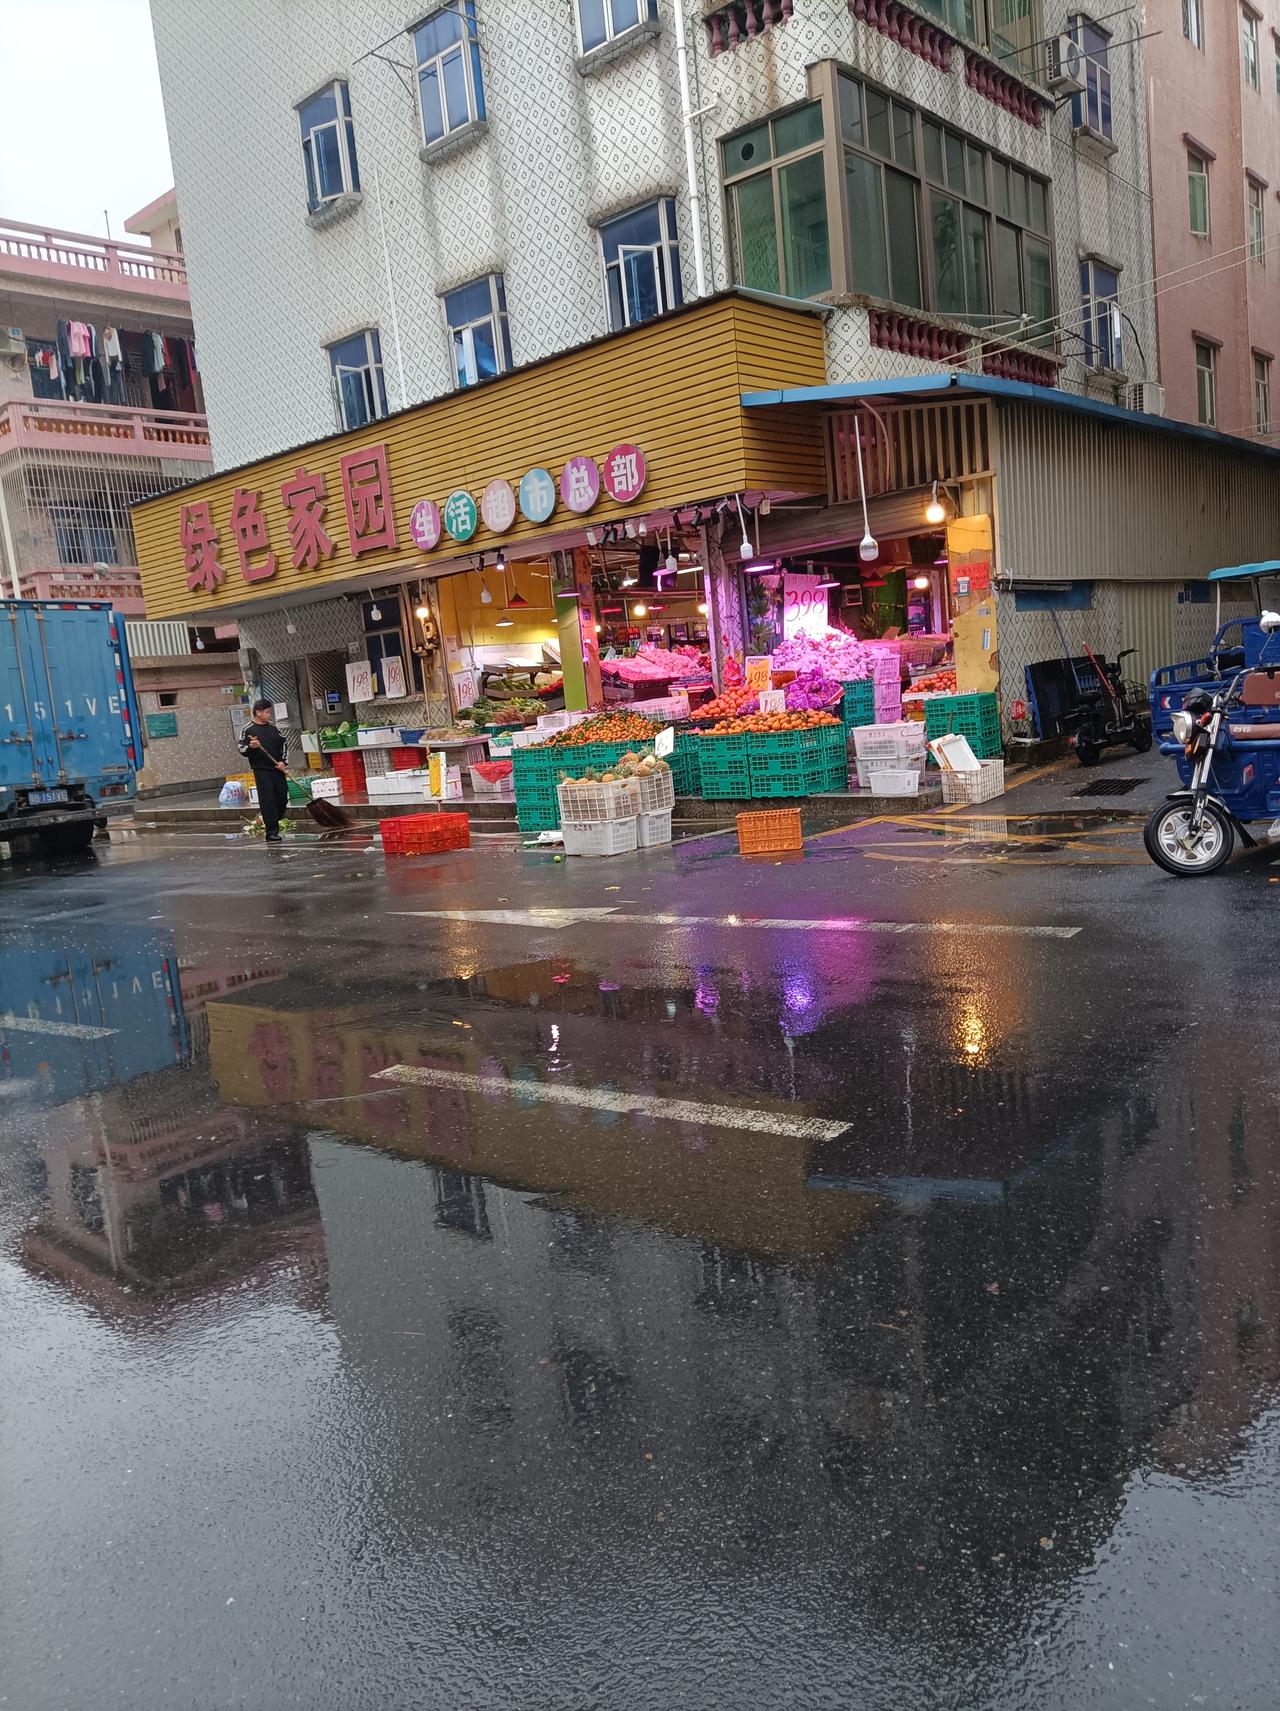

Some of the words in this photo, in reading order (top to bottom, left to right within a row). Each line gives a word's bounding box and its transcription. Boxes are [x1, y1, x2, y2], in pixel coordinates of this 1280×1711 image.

[179, 443, 399, 593] 绿色家园
[414, 453, 639, 543] 生活超市总部
